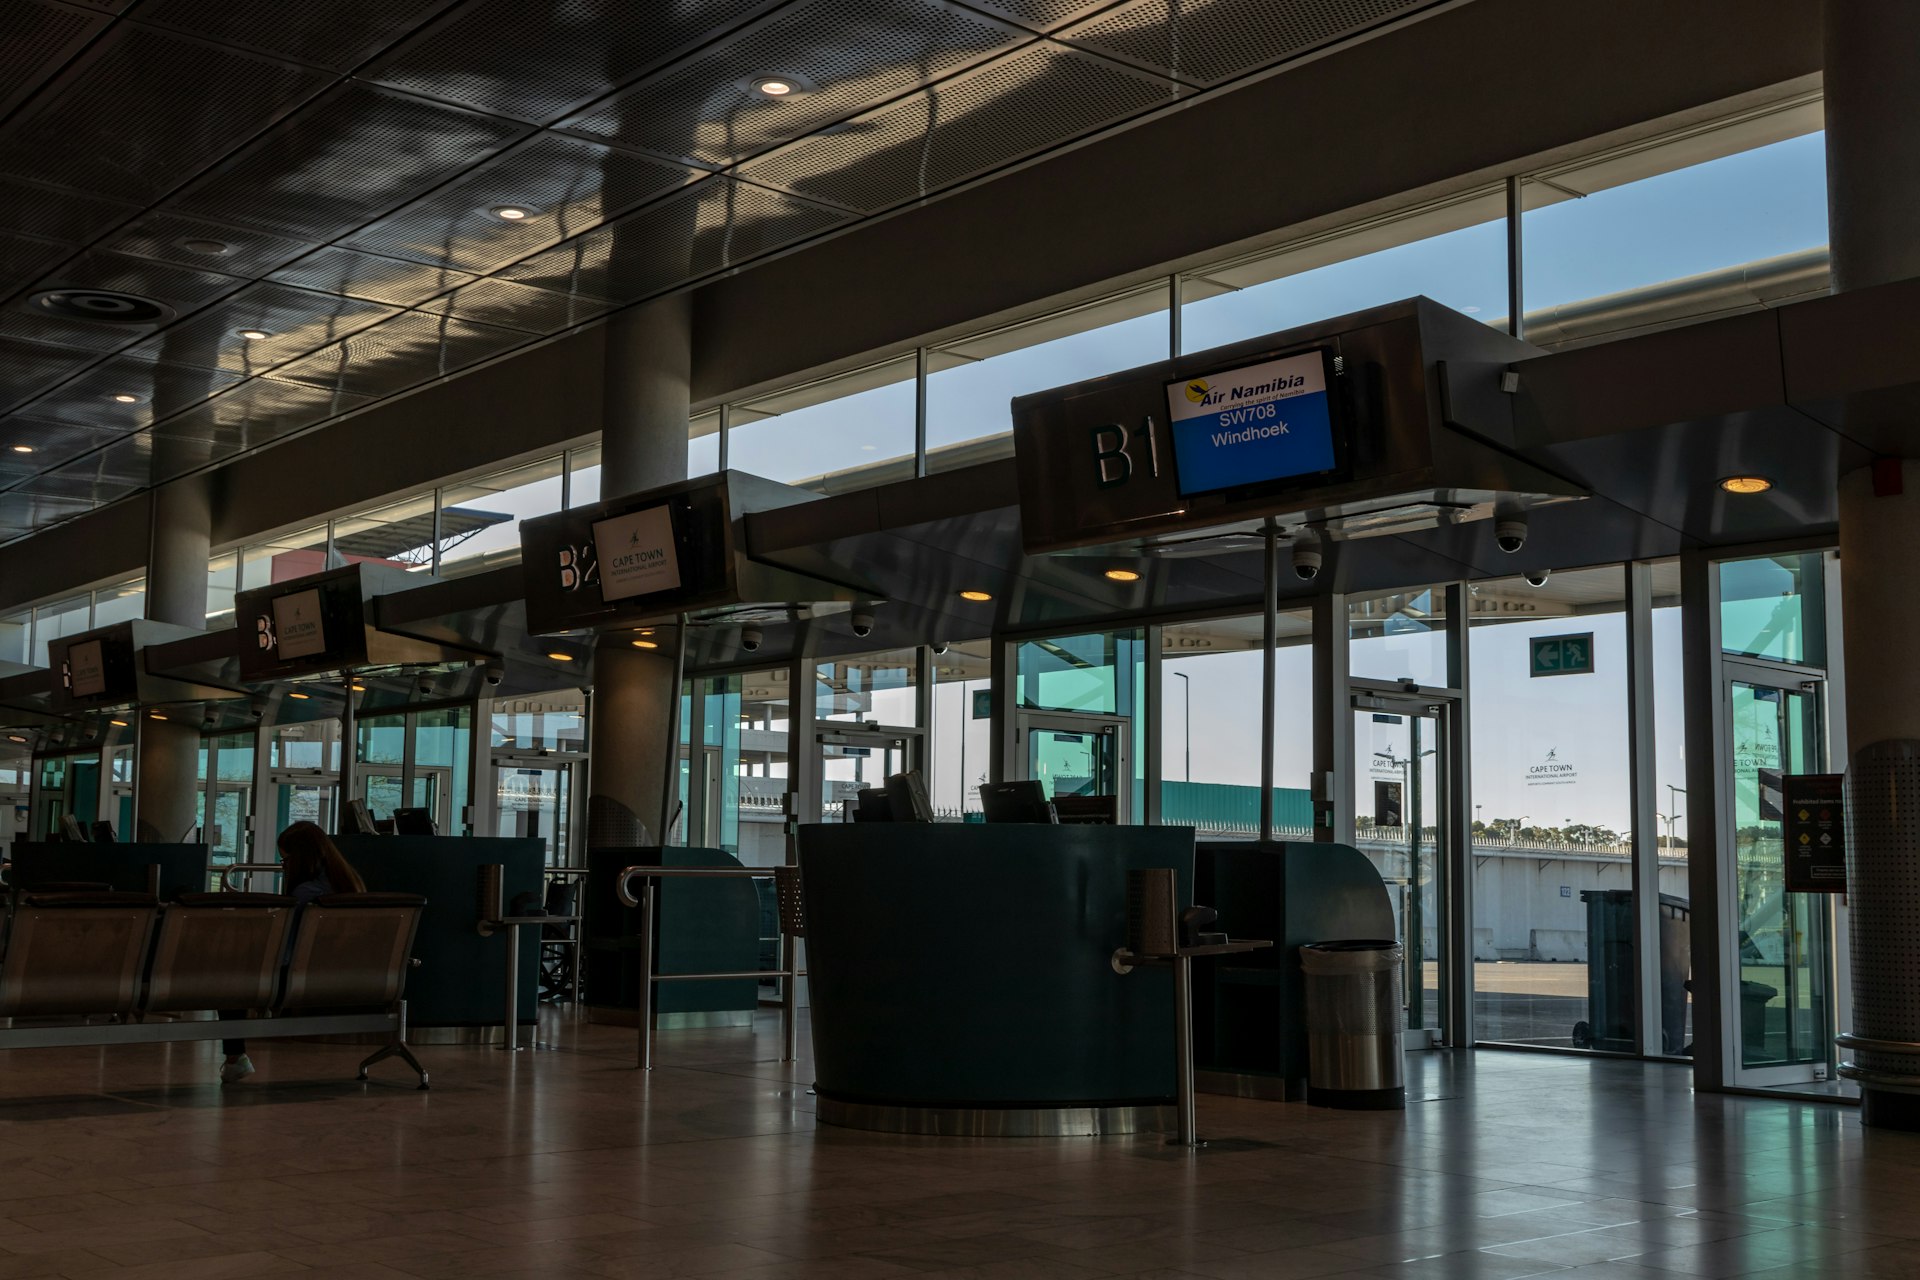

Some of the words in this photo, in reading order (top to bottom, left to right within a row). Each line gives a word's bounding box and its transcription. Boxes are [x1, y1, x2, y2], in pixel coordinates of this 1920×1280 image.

[1200, 391, 1226, 408] Air
[1230, 375, 1305, 401] Namibia
[1220, 401, 1244, 411] Carrying
[1256, 394, 1271, 404] spirit
[1272, 393, 1279, 401] of
[1280, 388, 1305, 399] Namibia
[1220, 403, 1276, 427] SW708
[1211, 420, 1290, 448] Windhoek
[1090, 415, 1158, 490] B1
[612, 554, 634, 568] CAPE
[635, 548, 663, 563] TOWN
[1530, 765, 1548, 773] CAPE
[1549, 764, 1573, 772] TOWN
